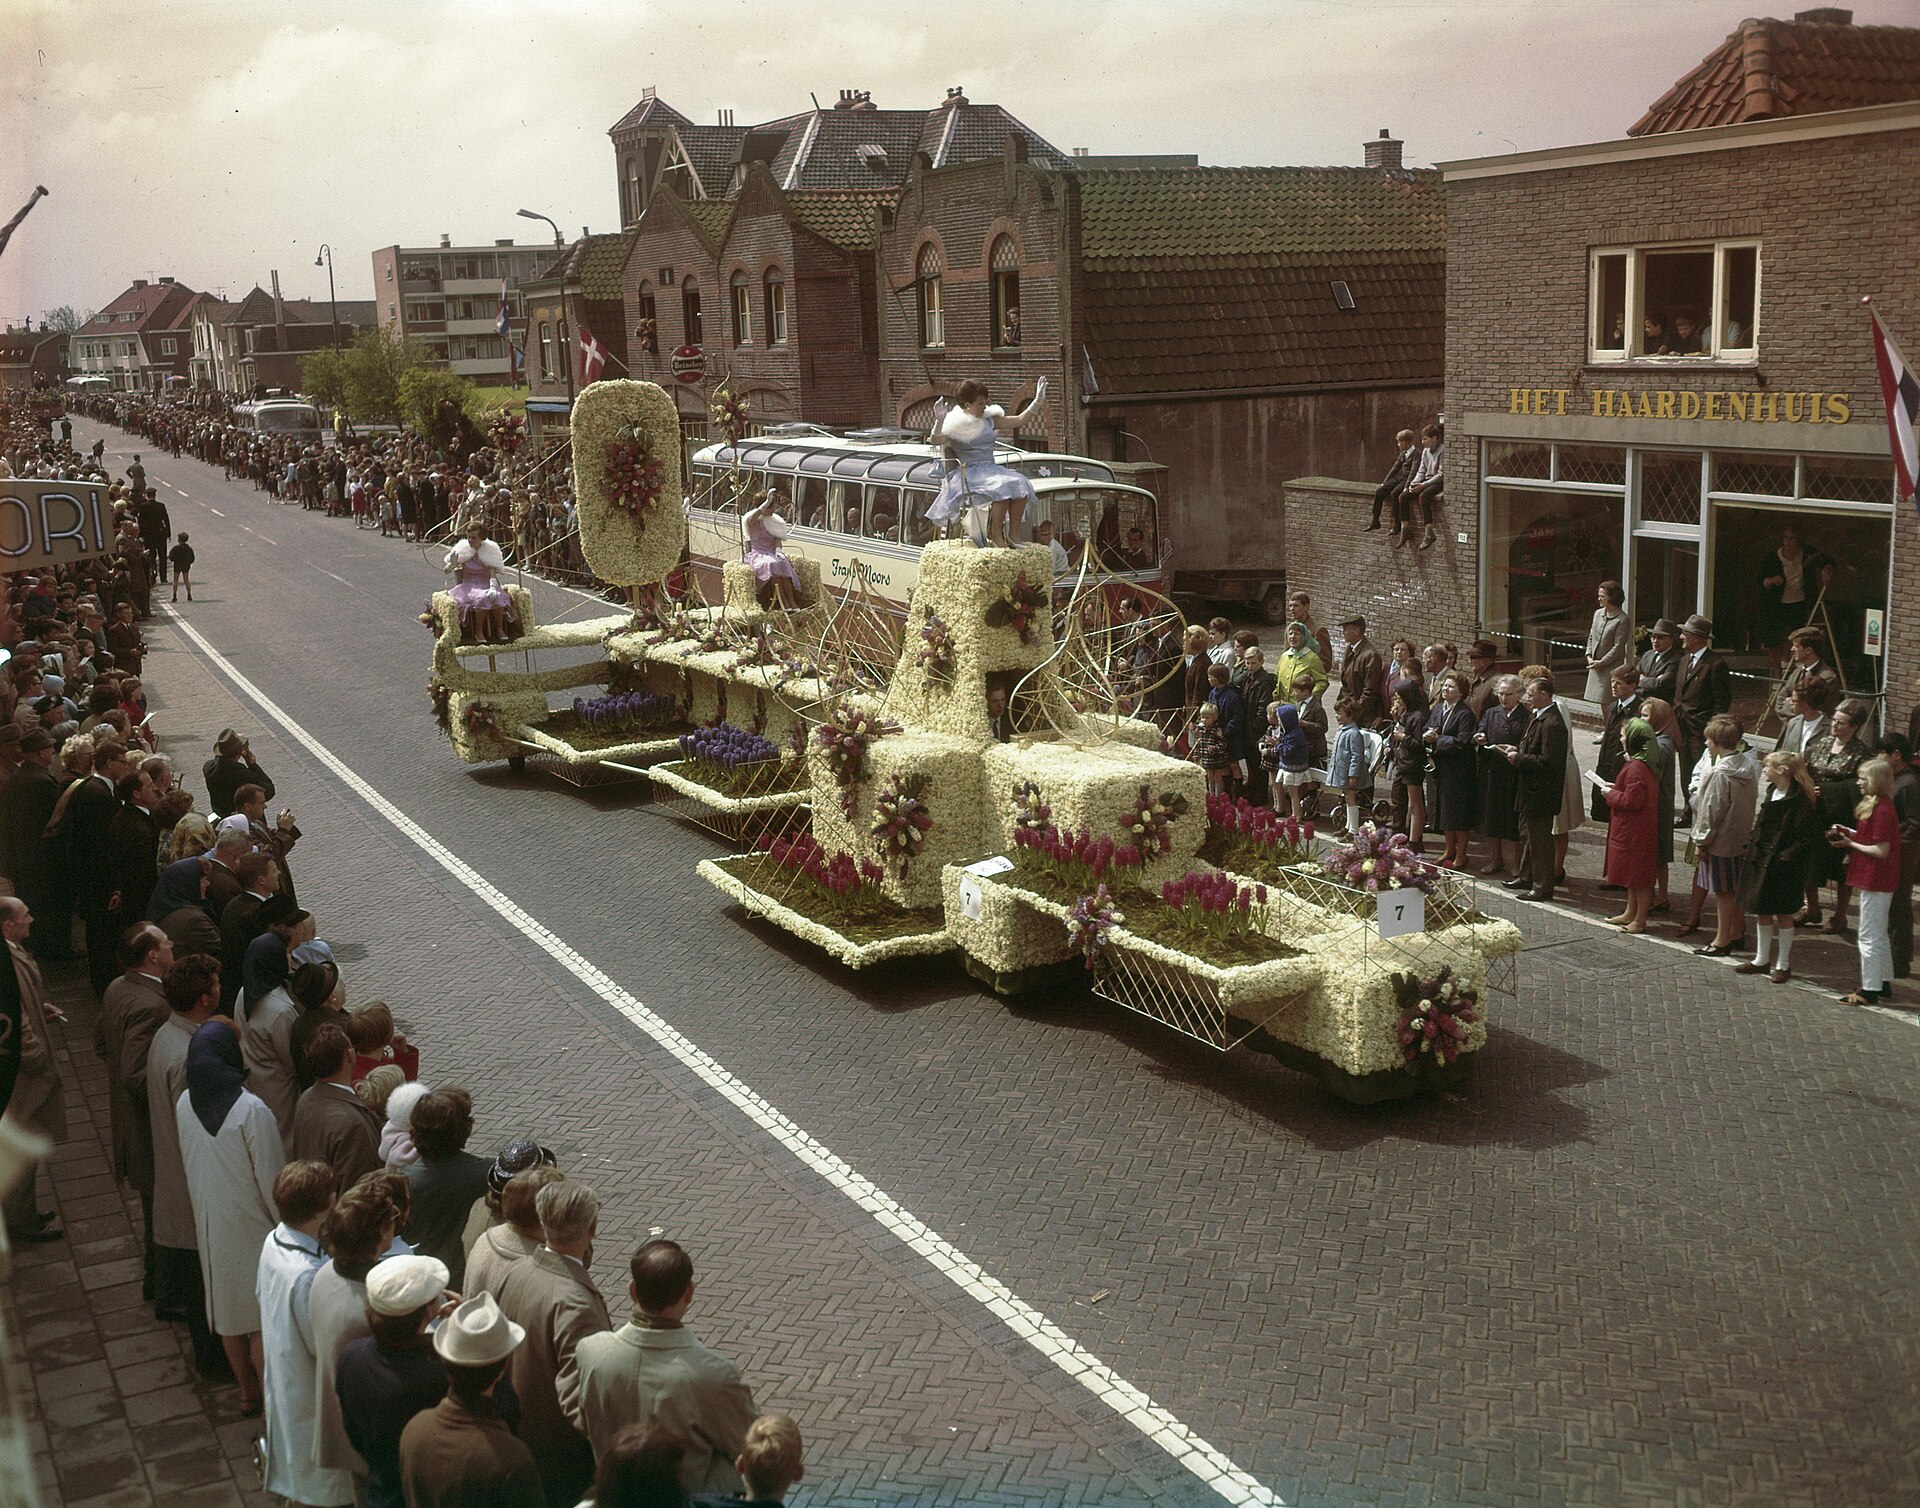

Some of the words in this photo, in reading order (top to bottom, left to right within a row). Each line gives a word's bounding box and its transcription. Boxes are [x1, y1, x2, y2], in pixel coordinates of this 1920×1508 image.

[1510, 389, 1570, 416] HET
[1592, 390, 1850, 424] HAARDENHUIS
[859, 563, 890, 586] Moors
[966, 892, 971, 906] 7
[1395, 904, 1405, 921] 7
